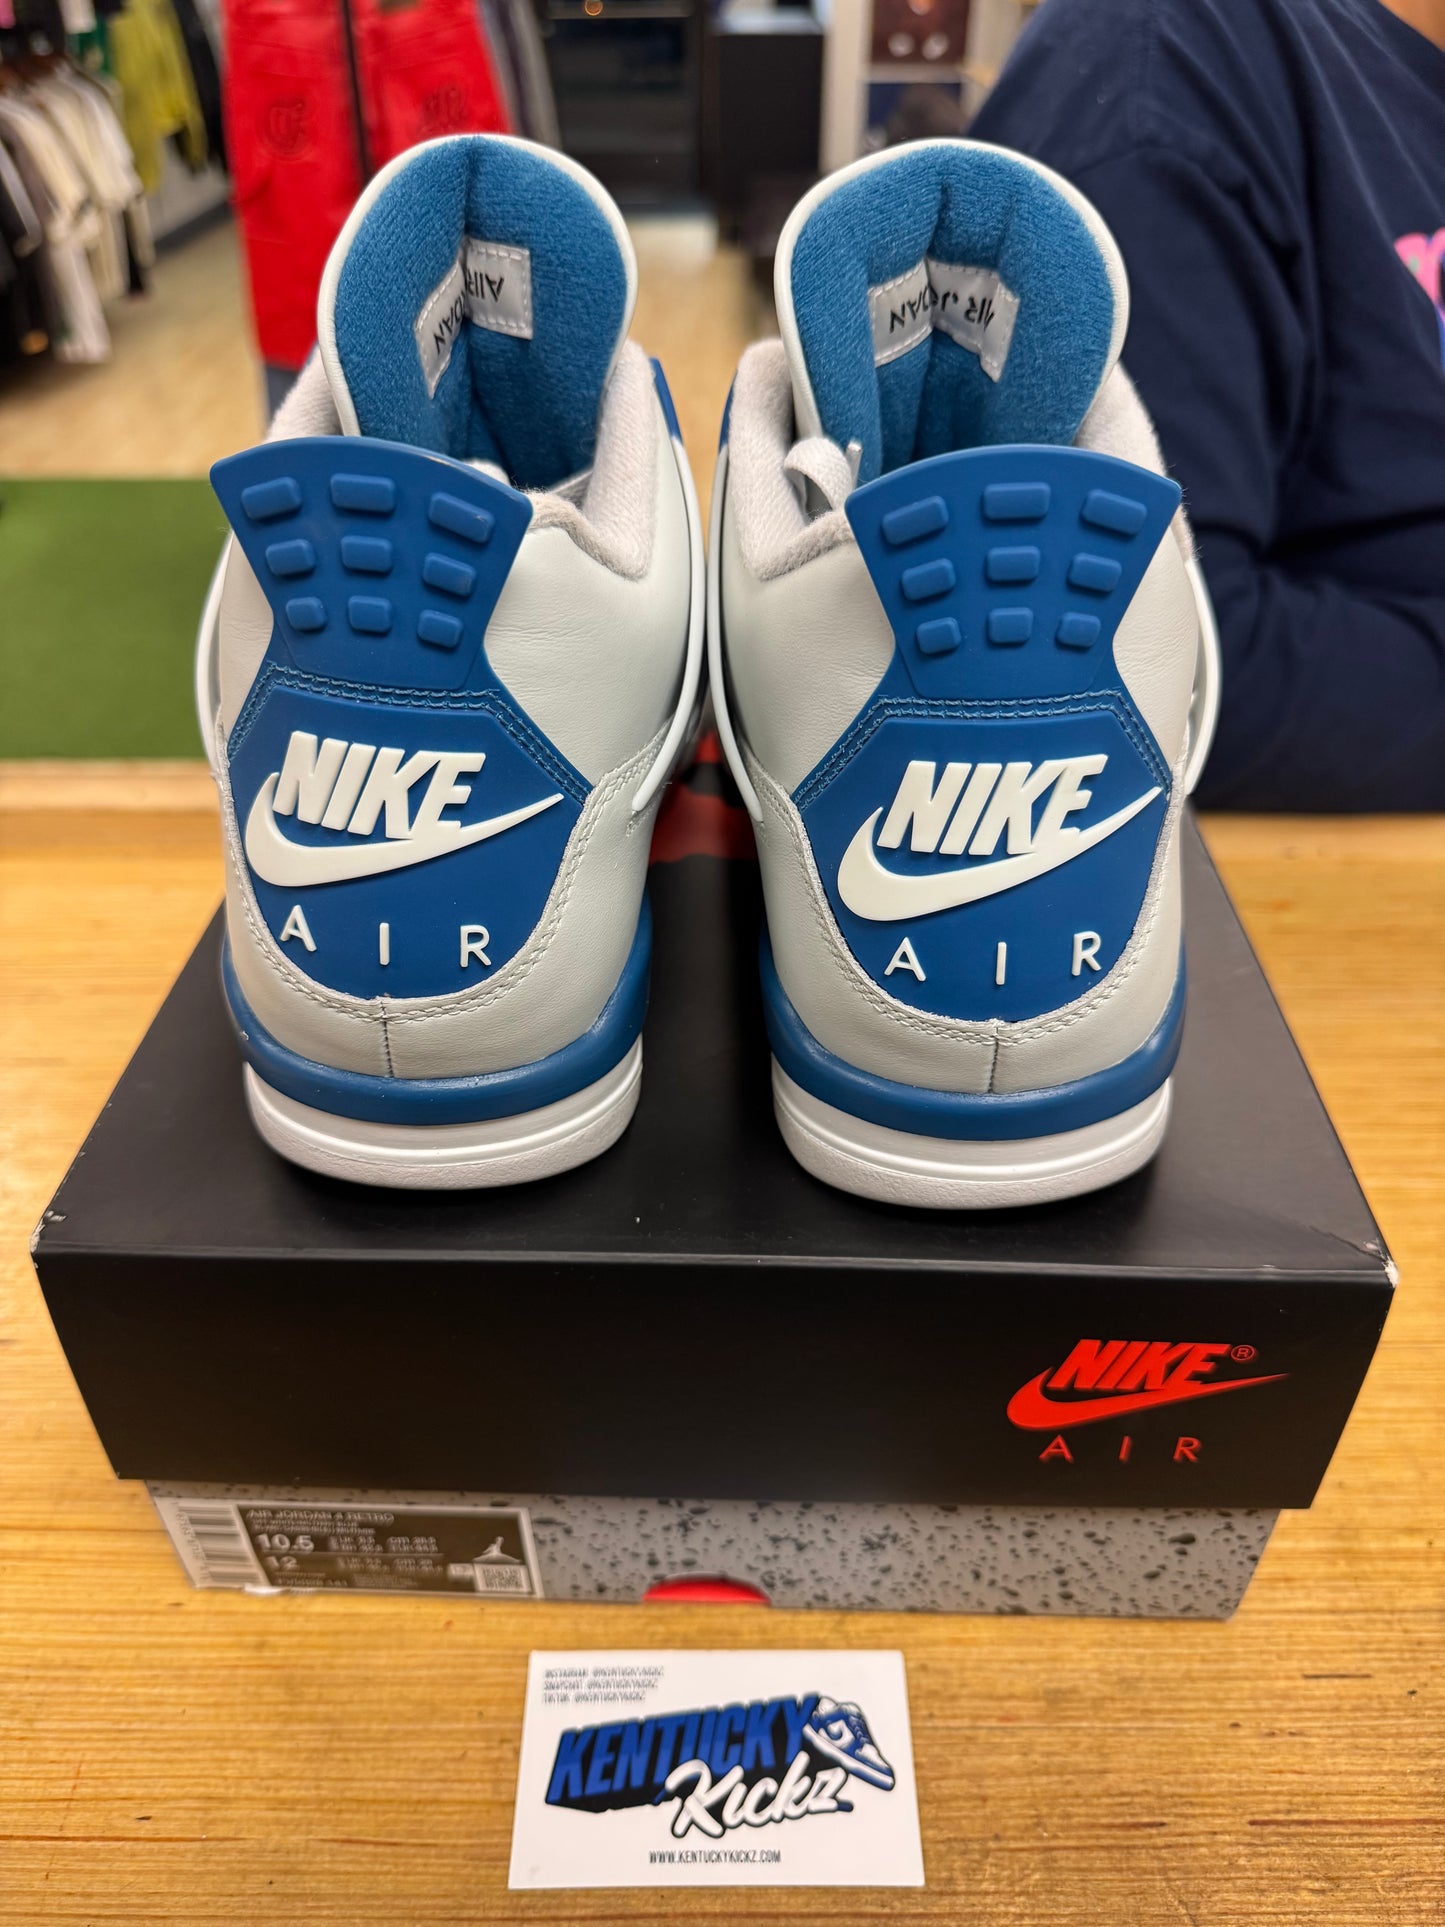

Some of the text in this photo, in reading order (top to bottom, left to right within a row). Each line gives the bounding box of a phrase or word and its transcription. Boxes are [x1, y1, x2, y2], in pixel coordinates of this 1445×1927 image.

[272, 730, 486, 840] NIKE
[877, 754, 1108, 855] NIKE
[280, 904, 492, 968] AIR
[884, 931, 1102, 985] AIR
[1038, 1434, 1201, 1463] AIR
[255, 1533, 316, 1554] 10.5
[546, 1693, 820, 1803] KENTUCKY
[649, 1849, 781, 1864] WWW.KENTUCKYKICKZ.COM
